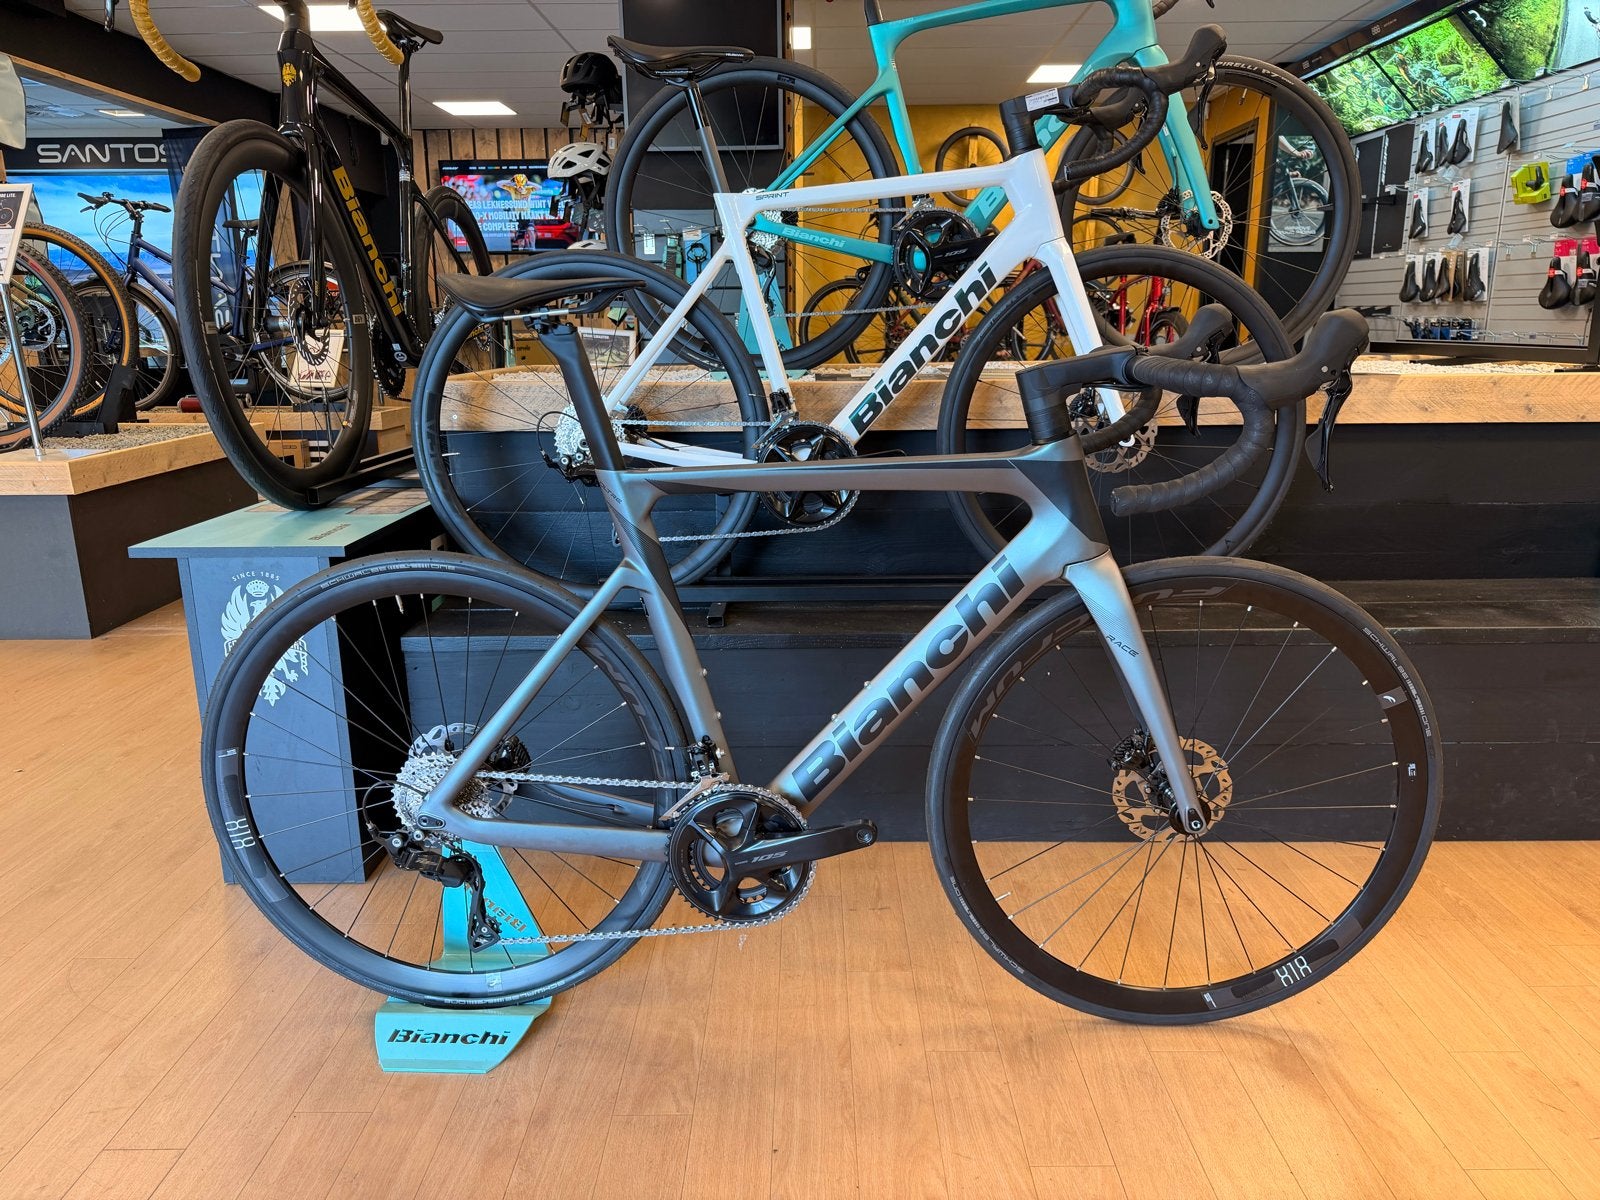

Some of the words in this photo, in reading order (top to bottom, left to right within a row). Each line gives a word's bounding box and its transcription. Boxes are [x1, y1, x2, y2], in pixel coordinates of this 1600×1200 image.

[1216, 61, 1259, 71] PIRELLI
[755, 191, 790, 201] SPRINT
[332, 165, 405, 317] Bianchi
[781, 226, 847, 248] Bianchi
[848, 261, 998, 436] Bianchi
[232, 571, 256, 581] SINCE
[260, 571, 280, 581] 1885
[1105, 634, 1140, 658] RACE
[1362, 627, 1409, 680] SCHWALBE
[792, 555, 1026, 801] Bianchi
[751, 850, 788, 864] 105
[979, 926, 1025, 975] SCHWALBE
[387, 1028, 511, 1045] Bianchi
